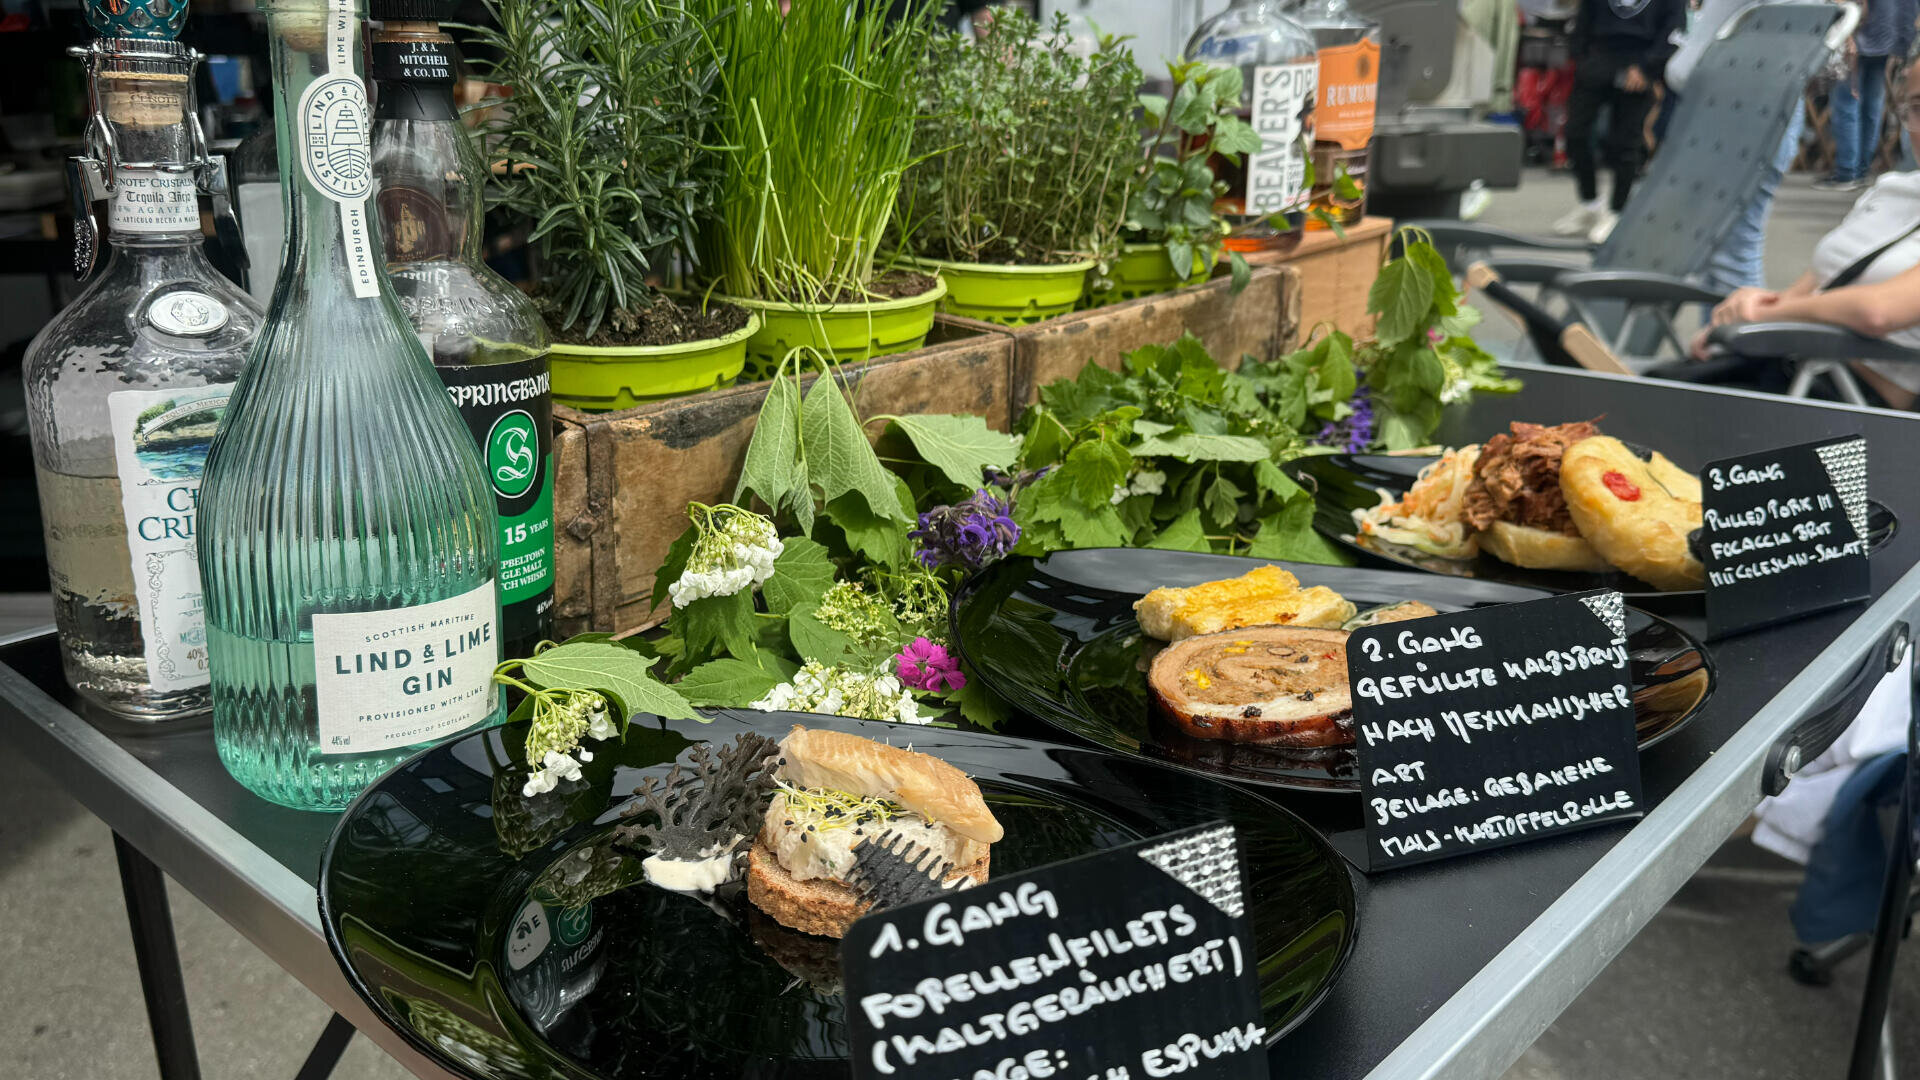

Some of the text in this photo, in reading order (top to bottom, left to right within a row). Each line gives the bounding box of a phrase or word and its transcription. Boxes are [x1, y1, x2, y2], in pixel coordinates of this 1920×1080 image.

[337, 37, 345, 64] LIME
[399, 55, 449, 66] MITCHELL
[403, 68, 449, 78] & CO. LTD.
[1255, 69, 1291, 209] BEAVER'S
[125, 191, 164, 205] Tequila
[138, 206, 181, 214] AGAVE
[350, 210, 370, 284] EDINBURGH
[446, 371, 551, 408] SPRINGBANK
[504, 518, 549, 545] 15 YEARS
[1704, 507, 1767, 532] PULLED
[1710, 531, 1792, 560] FOCACCIA
[519, 567, 548, 587] WHISKY
[522, 559, 543, 576] MALT
[365, 613, 475, 643] SCOTTISH MARITIME
[335, 621, 491, 675] LIND & LIME
[1361, 637, 1395, 663] 2.
[402, 666, 453, 696] GIN
[359, 685, 483, 722] PROVISIONED WITH LIME
[385, 728, 422, 740] PRODUCT
[1371, 760, 1425, 787] ART
[1370, 787, 1480, 826] BEILAGE:
